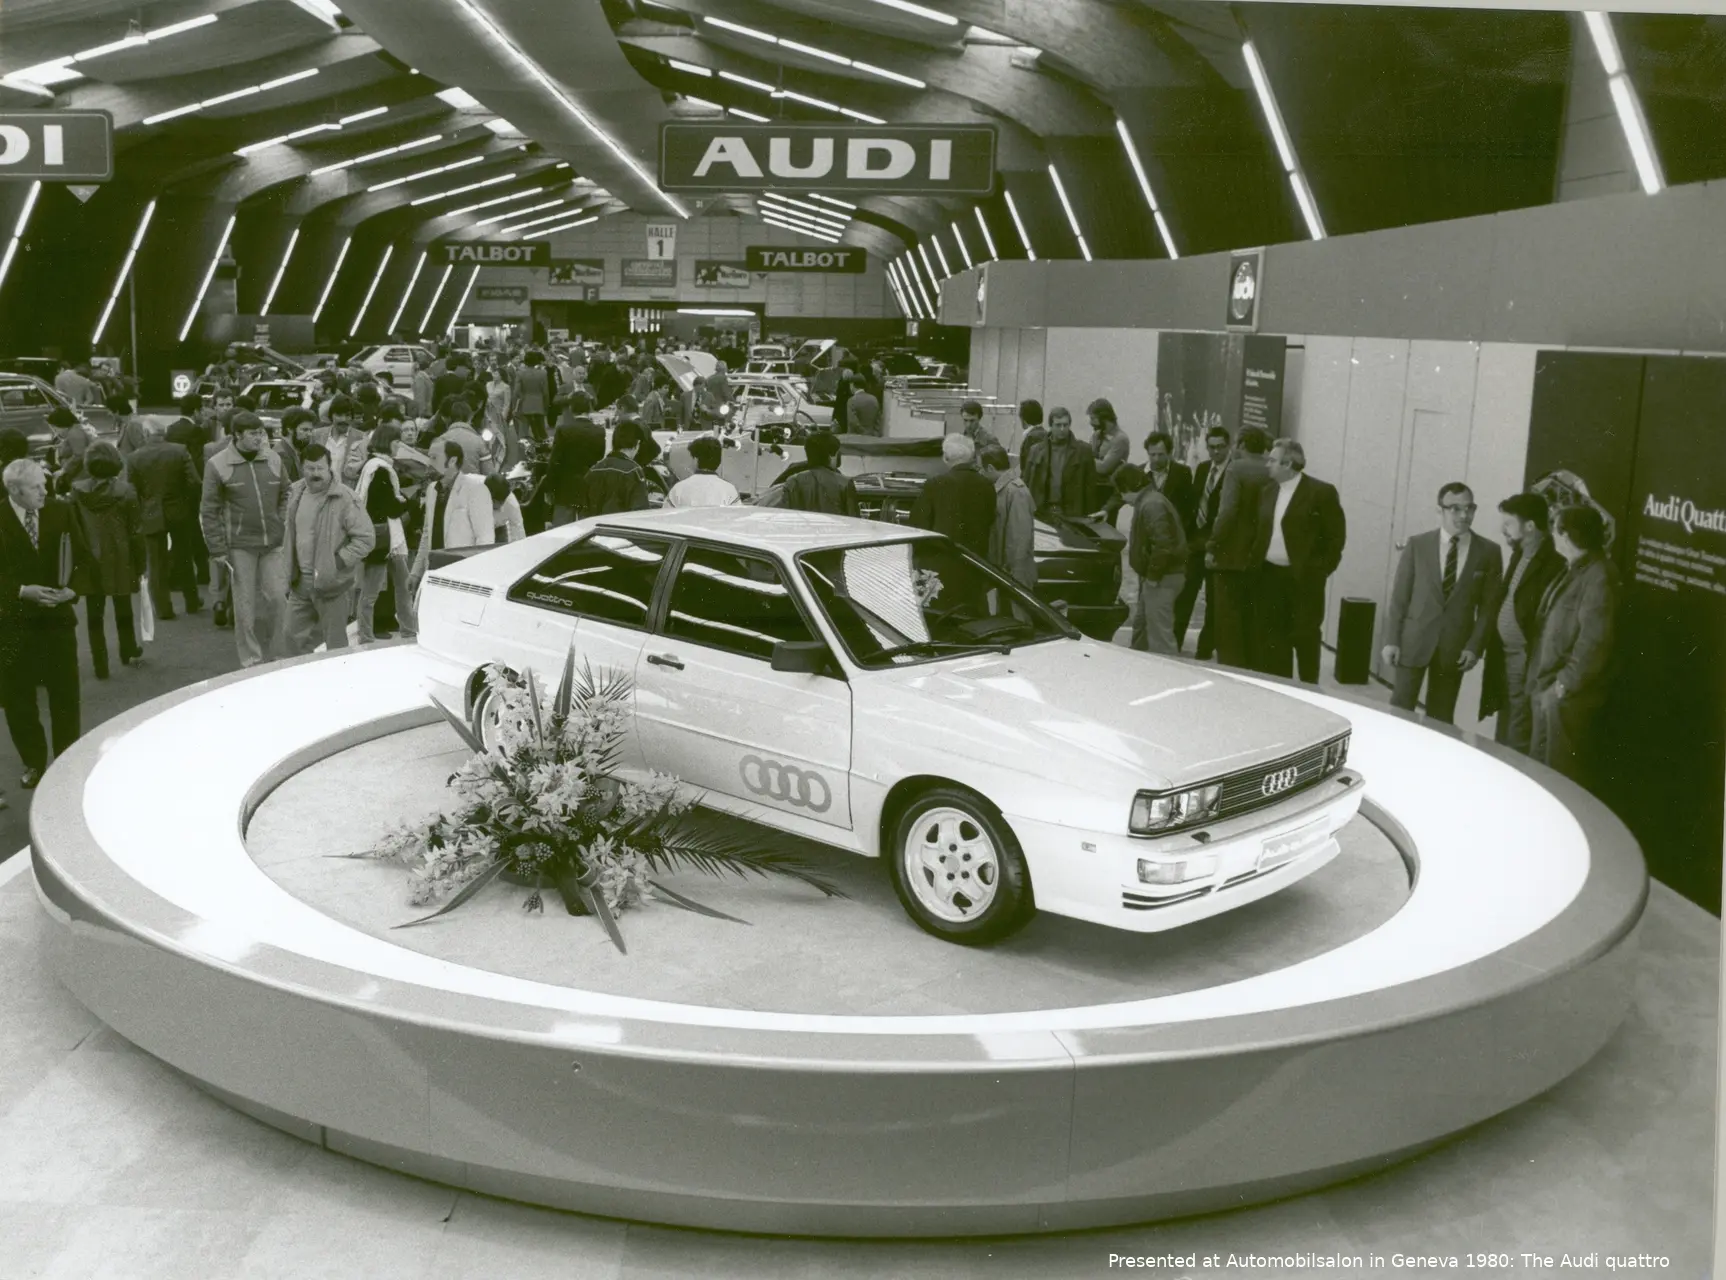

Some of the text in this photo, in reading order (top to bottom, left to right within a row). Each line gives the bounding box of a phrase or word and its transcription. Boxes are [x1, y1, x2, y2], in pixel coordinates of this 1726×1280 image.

[692, 137, 952, 180] AUDI
[445, 246, 536, 261] TALBOT
[657, 239, 664, 257] 1
[760, 251, 851, 267] TALBOT
[587, 288, 596, 300] F
[1643, 493, 1726, 534] Audi Quatt
[526, 591, 573, 606] quattro
